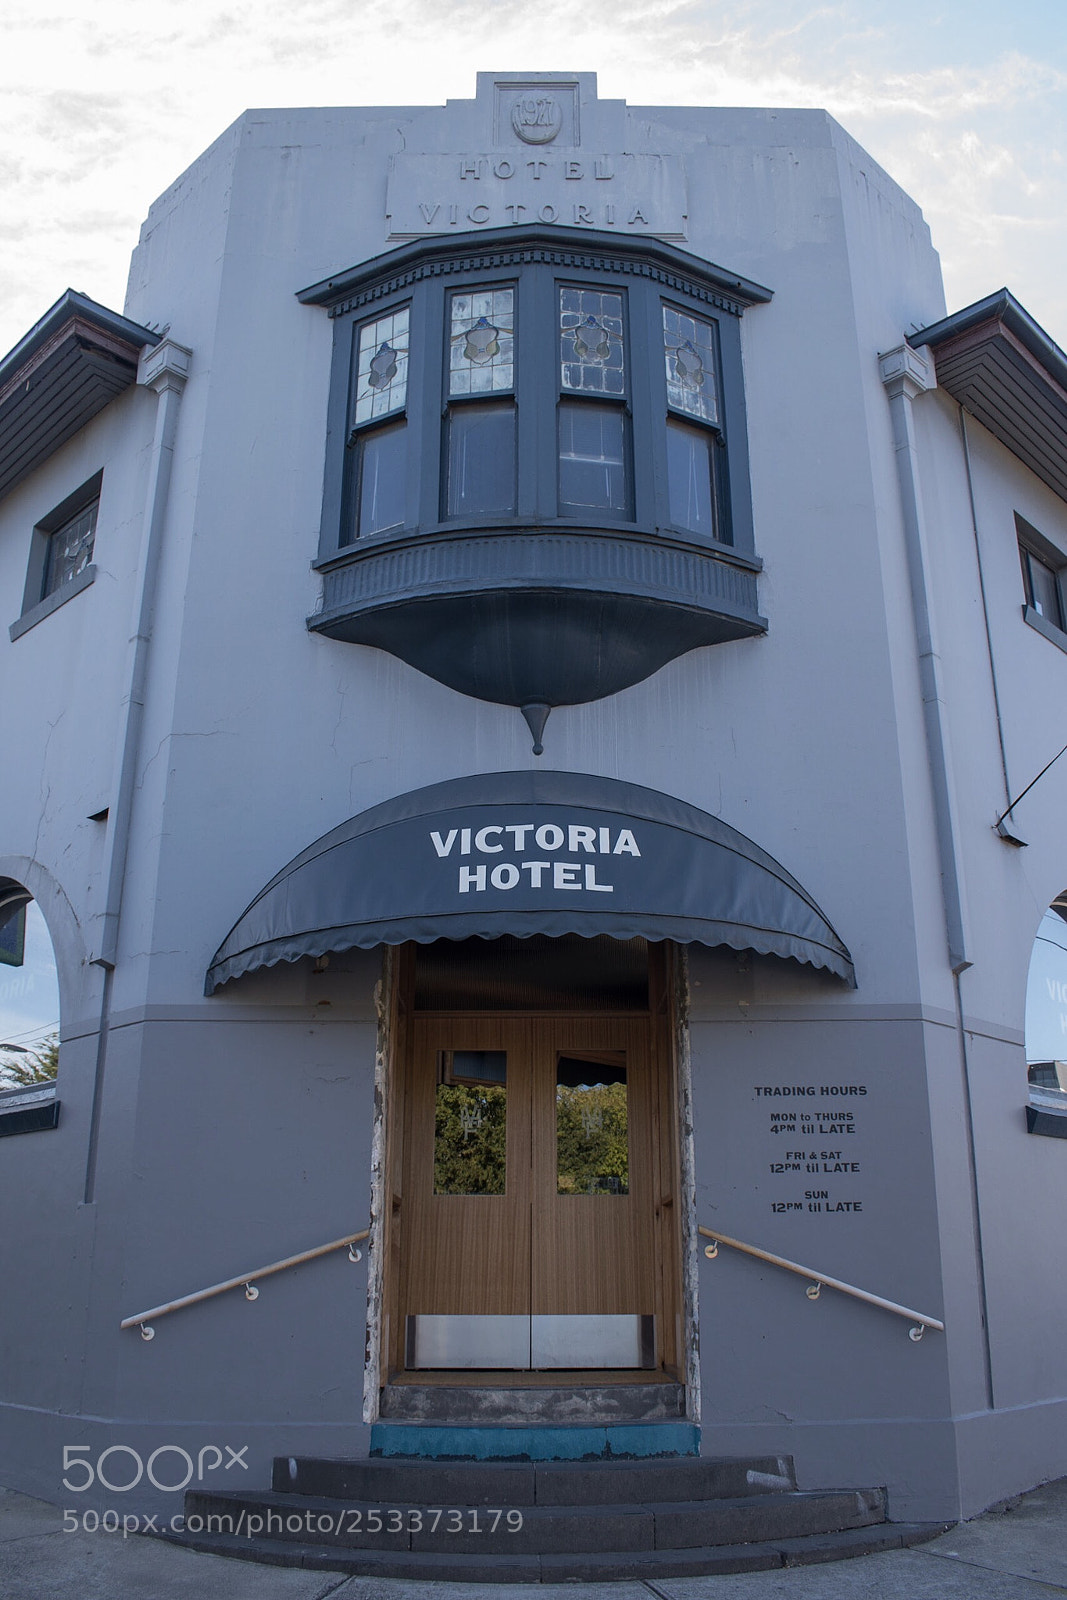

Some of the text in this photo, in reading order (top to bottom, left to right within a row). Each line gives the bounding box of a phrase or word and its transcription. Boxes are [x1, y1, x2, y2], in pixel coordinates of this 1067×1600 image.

[459, 160, 615, 181] HOTEL
[418, 203, 649, 225] VICTORIA
[429, 823, 641, 858] VICTORIA
[458, 861, 614, 893] HOTEL
[754, 1086, 868, 1097] TRADING HOURS
[770, 1112, 854, 1121] MON to THURS
[770, 1124, 856, 1135] 4PM til LATE
[786, 1151, 842, 1160] FRI & SAT
[769, 1162, 860, 1174] 12PM til LATE
[804, 1190, 829, 1200] SUN
[771, 1201, 863, 1213] 12PM til LATE
